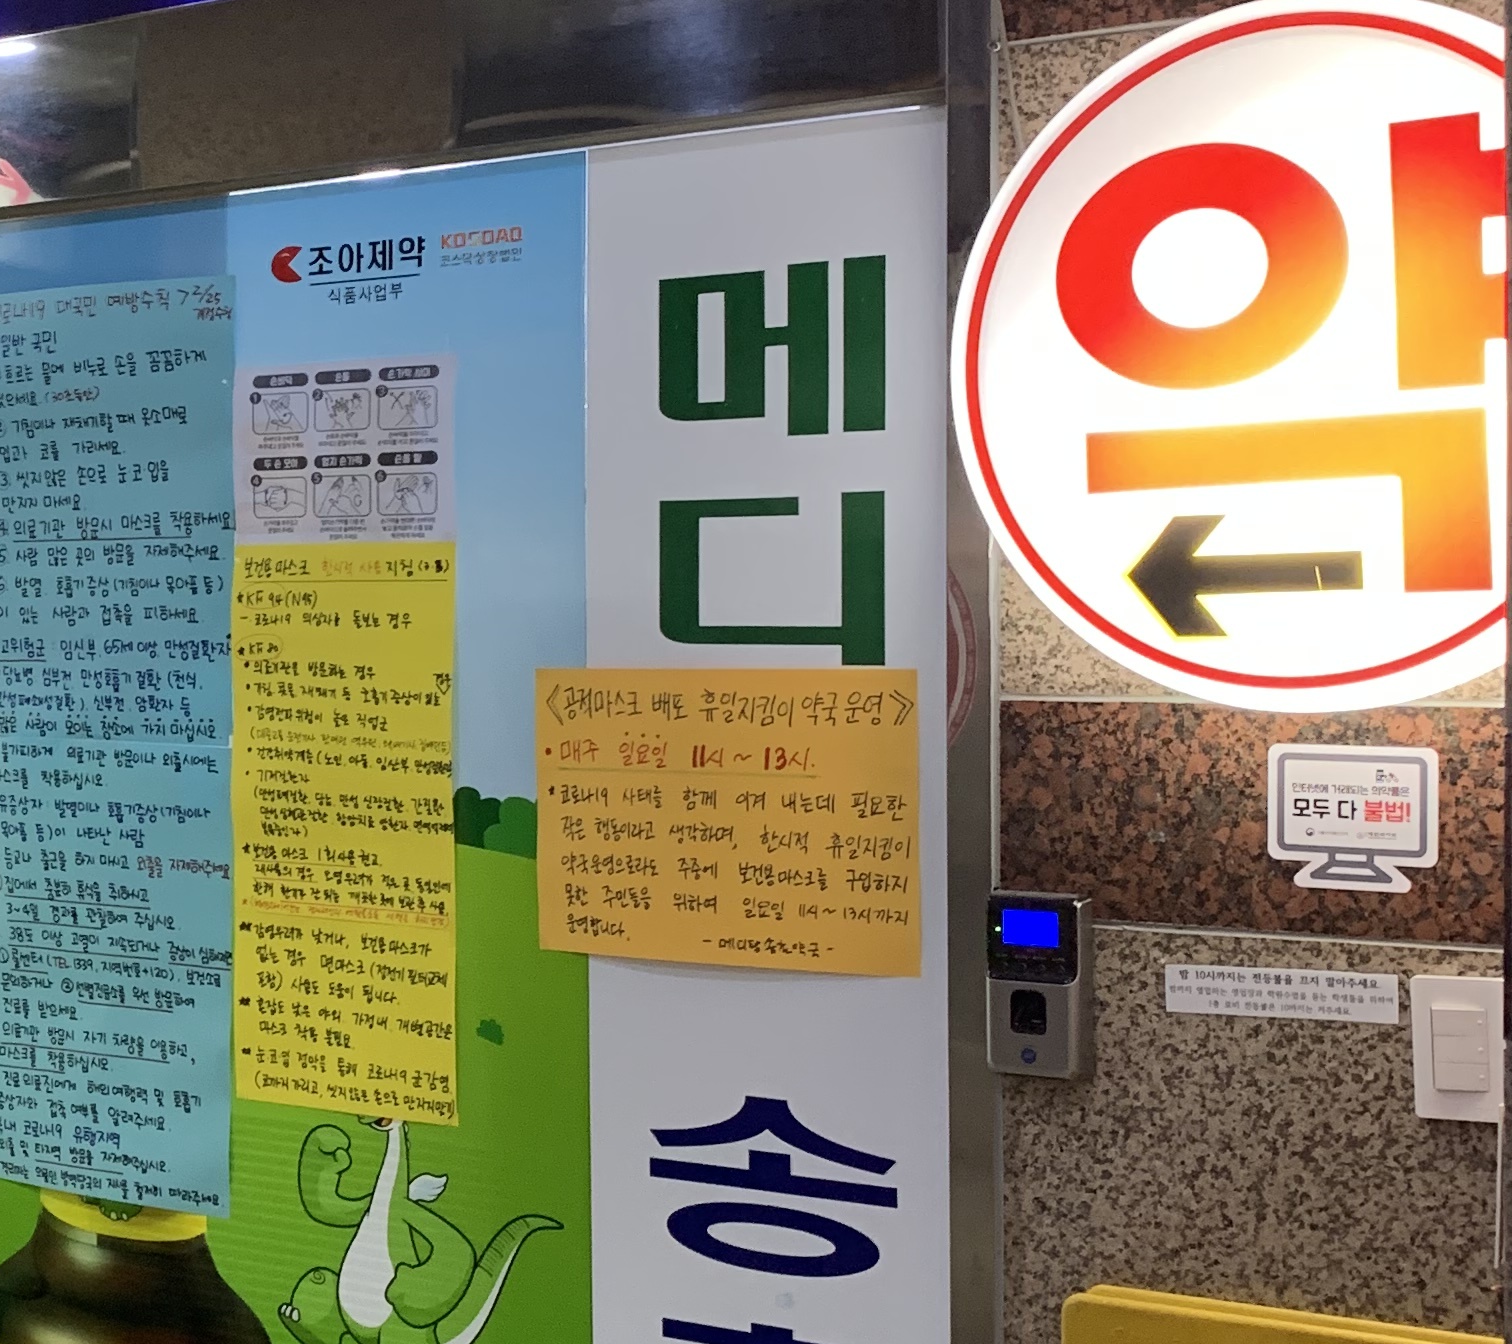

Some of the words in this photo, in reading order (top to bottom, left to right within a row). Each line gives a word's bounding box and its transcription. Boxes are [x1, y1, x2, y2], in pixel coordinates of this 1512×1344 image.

[308, 235, 426, 277] 조아제약
[328, 283, 404, 306] 식품사업부
[31, 331, 57, 354] 국민
[1056, 112, 1506, 593] 약
[74, 357, 108, 376] 비누로
[114, 353, 137, 376] 손을
[145, 348, 207, 372] 꼼꼼하게
[121, 511, 161, 536] 마스크를
[52, 606, 89, 627] 사람과
[651, 691, 688, 720] 배포
[699, 688, 794, 727] 휴일지킴이
[801, 691, 838, 727] 약국
[560, 739, 599, 762] 매주
[619, 741, 668, 769] 일요일
[692, 744, 724, 769] 11시
[622, 785, 663, 809] 사태를
[682, 788, 717, 811] 함께
[736, 792, 766, 812] 이겨
[782, 792, 836, 814] 내는데
[851, 791, 908, 822] 필요한
[1292, 798, 1331, 819] 모두
[1338, 799, 1358, 820] 다
[1363, 799, 1411, 823] 불법!
[561, 816, 587, 841] 작은
[594, 818, 656, 841] 행동이라고
[760, 829, 809, 857] 한시적
[826, 832, 912, 861] 휴일지킴이
[677, 857, 718, 881] 주중에
[846, 866, 908, 895] 구입하지
[565, 885, 589, 907] 못한
[602, 885, 652, 911] 주민들을
[673, 892, 718, 913] 위하여
[742, 897, 785, 921] 일요일
